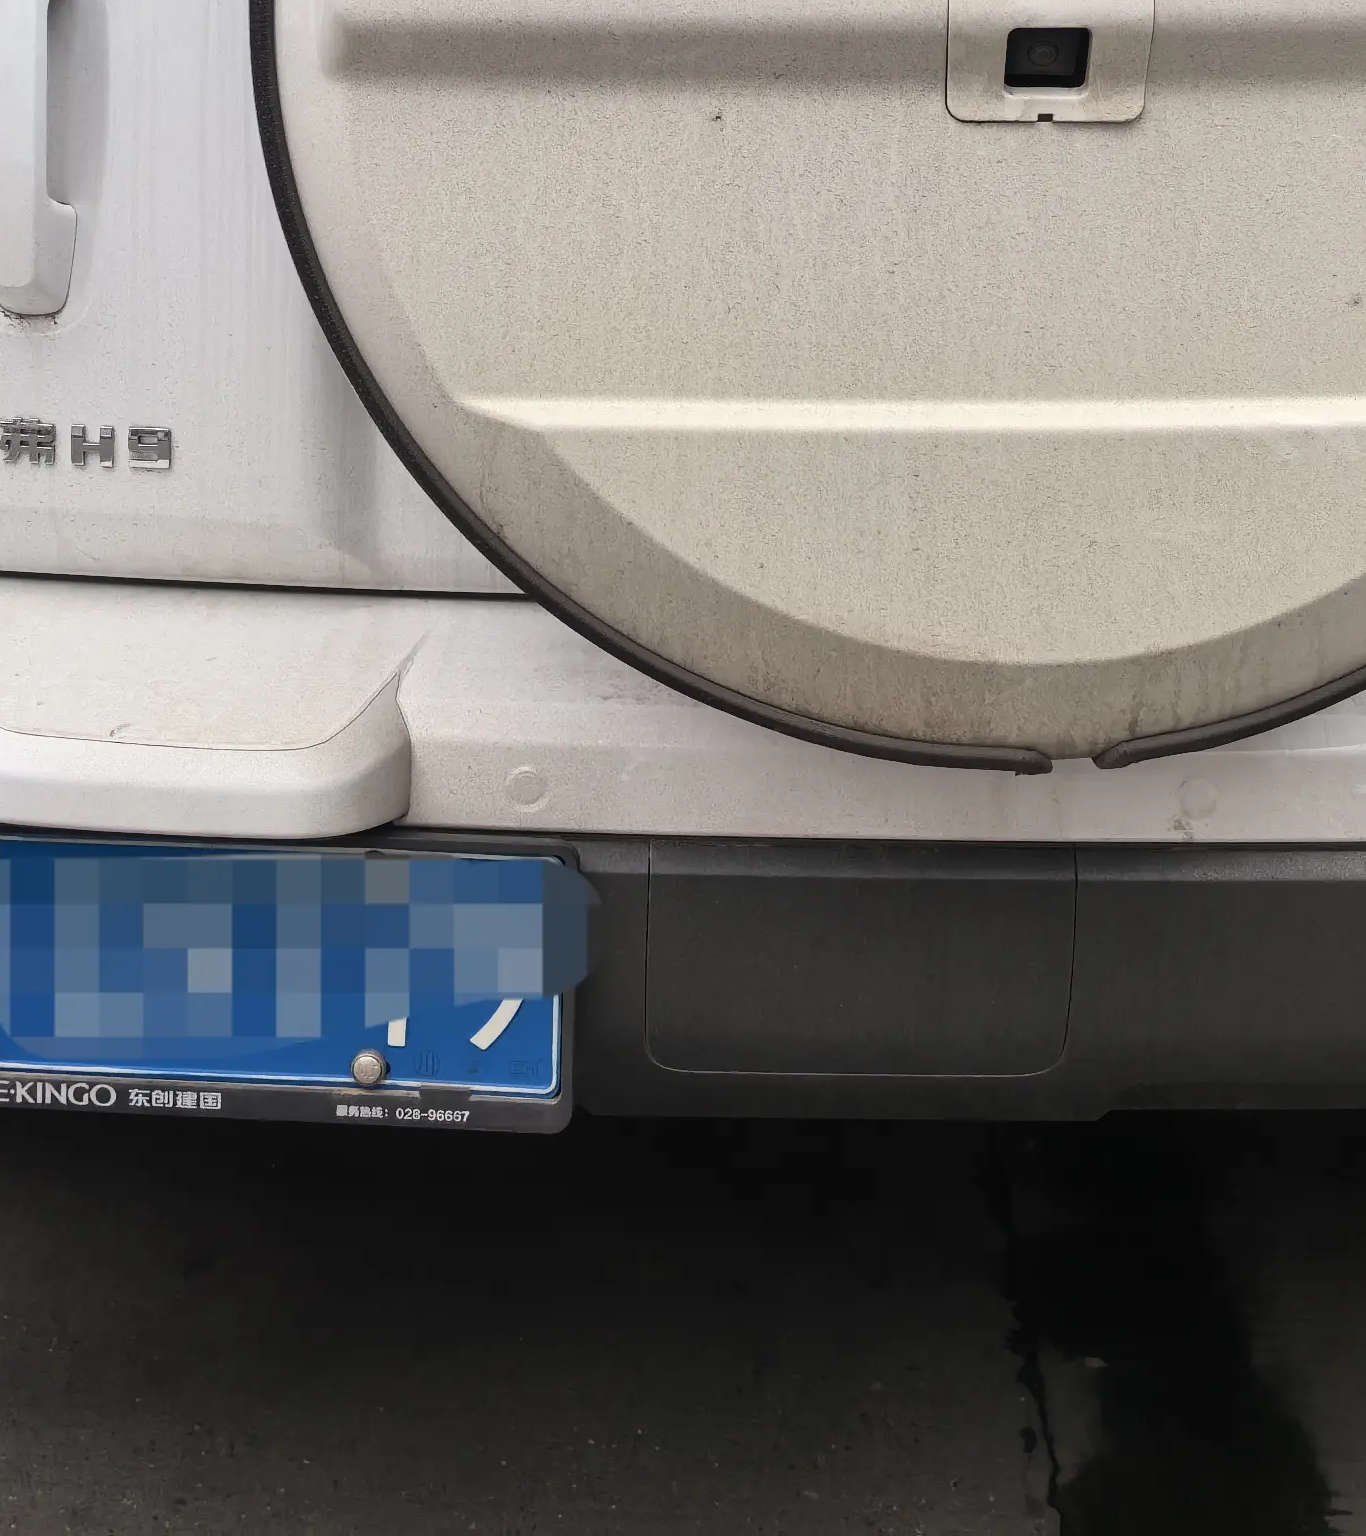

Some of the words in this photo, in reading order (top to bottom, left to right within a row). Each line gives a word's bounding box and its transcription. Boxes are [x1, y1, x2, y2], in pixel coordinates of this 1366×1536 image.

[128, 1088, 223, 1110] 东创建国
[395, 1107, 470, 1122] 028-96667
